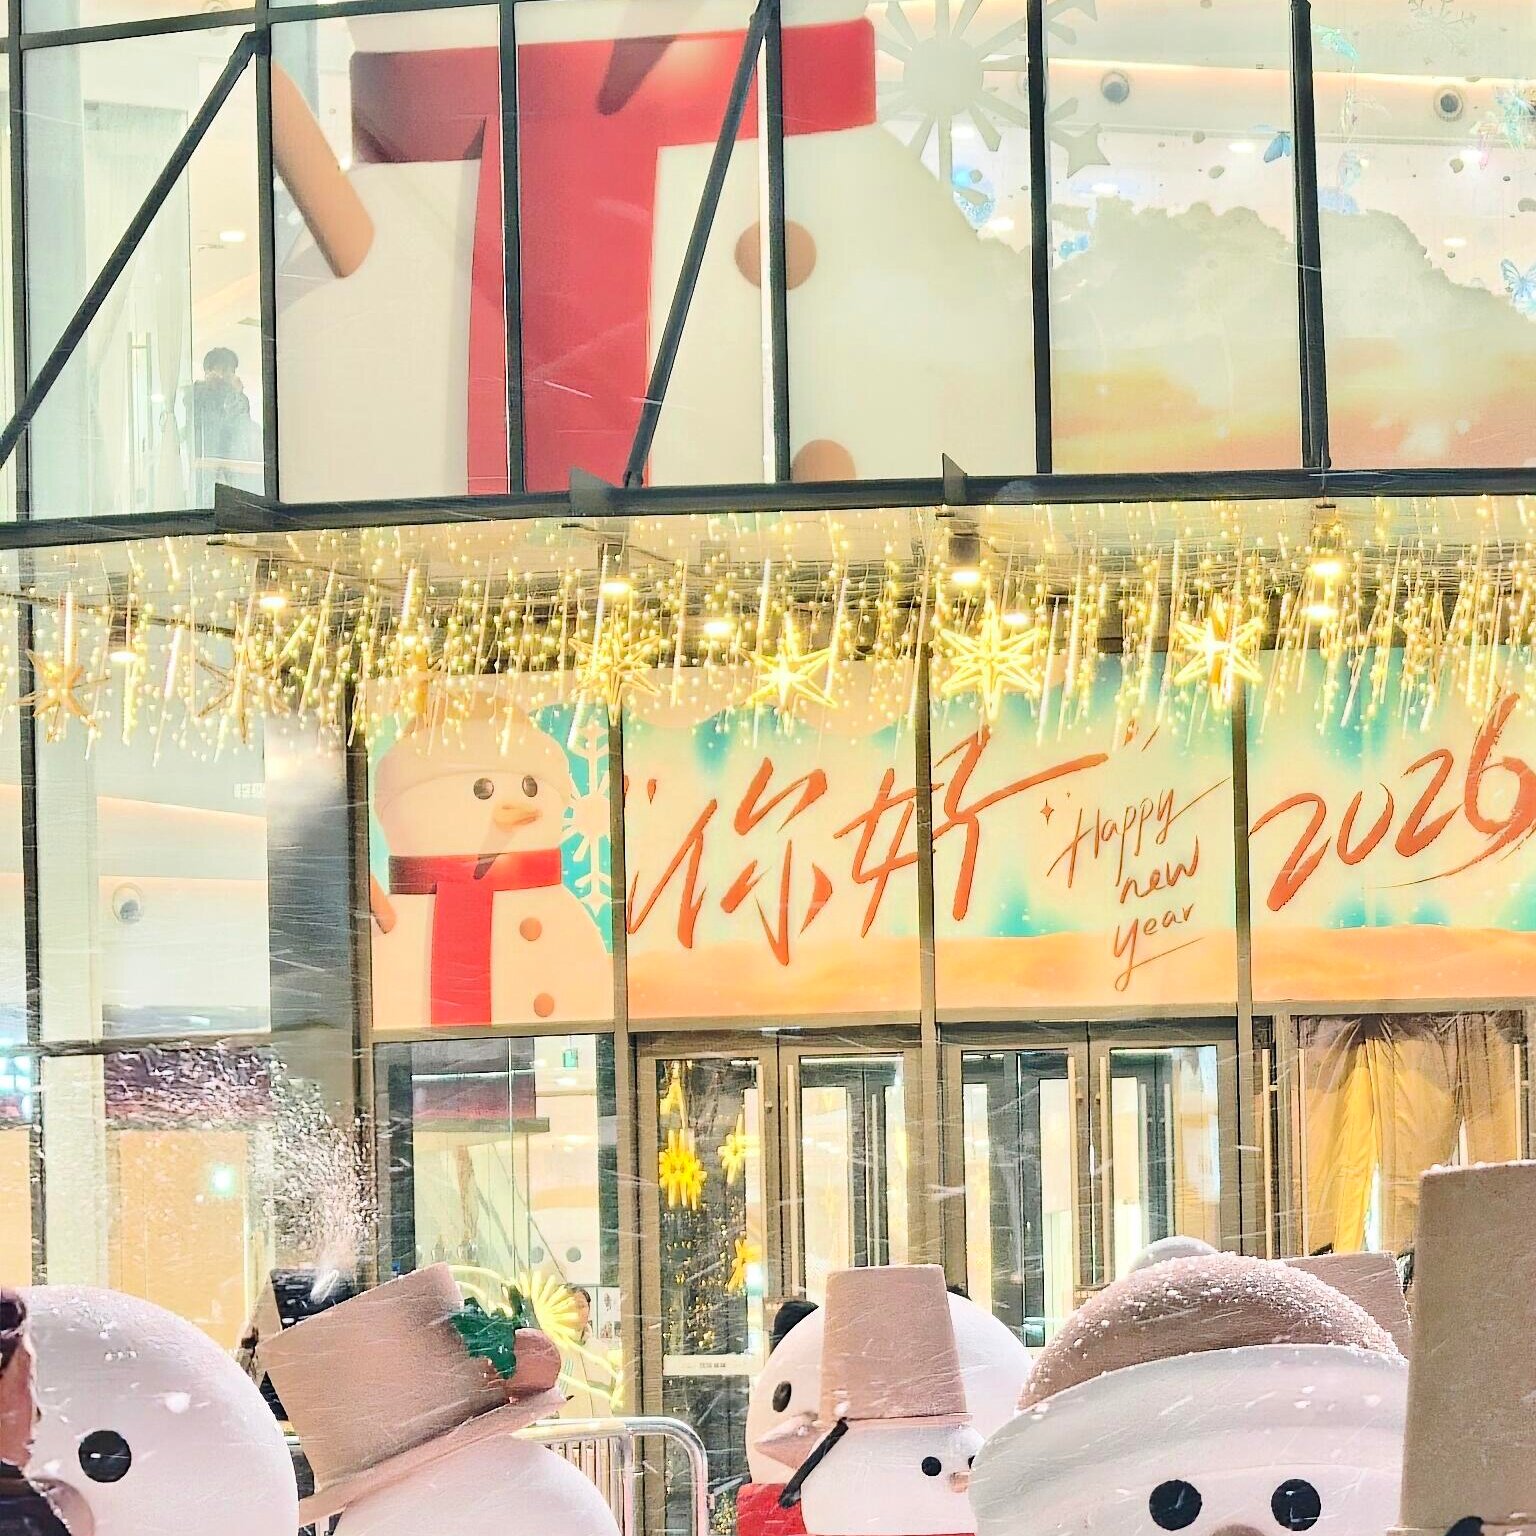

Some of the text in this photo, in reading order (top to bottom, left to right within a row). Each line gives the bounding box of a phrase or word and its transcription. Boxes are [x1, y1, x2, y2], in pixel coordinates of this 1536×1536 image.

[626, 725, 1109, 966] 你好
[1046, 776, 1231, 889] Happy
[1119, 834, 1200, 904] new
[1113, 903, 1205, 992] year
